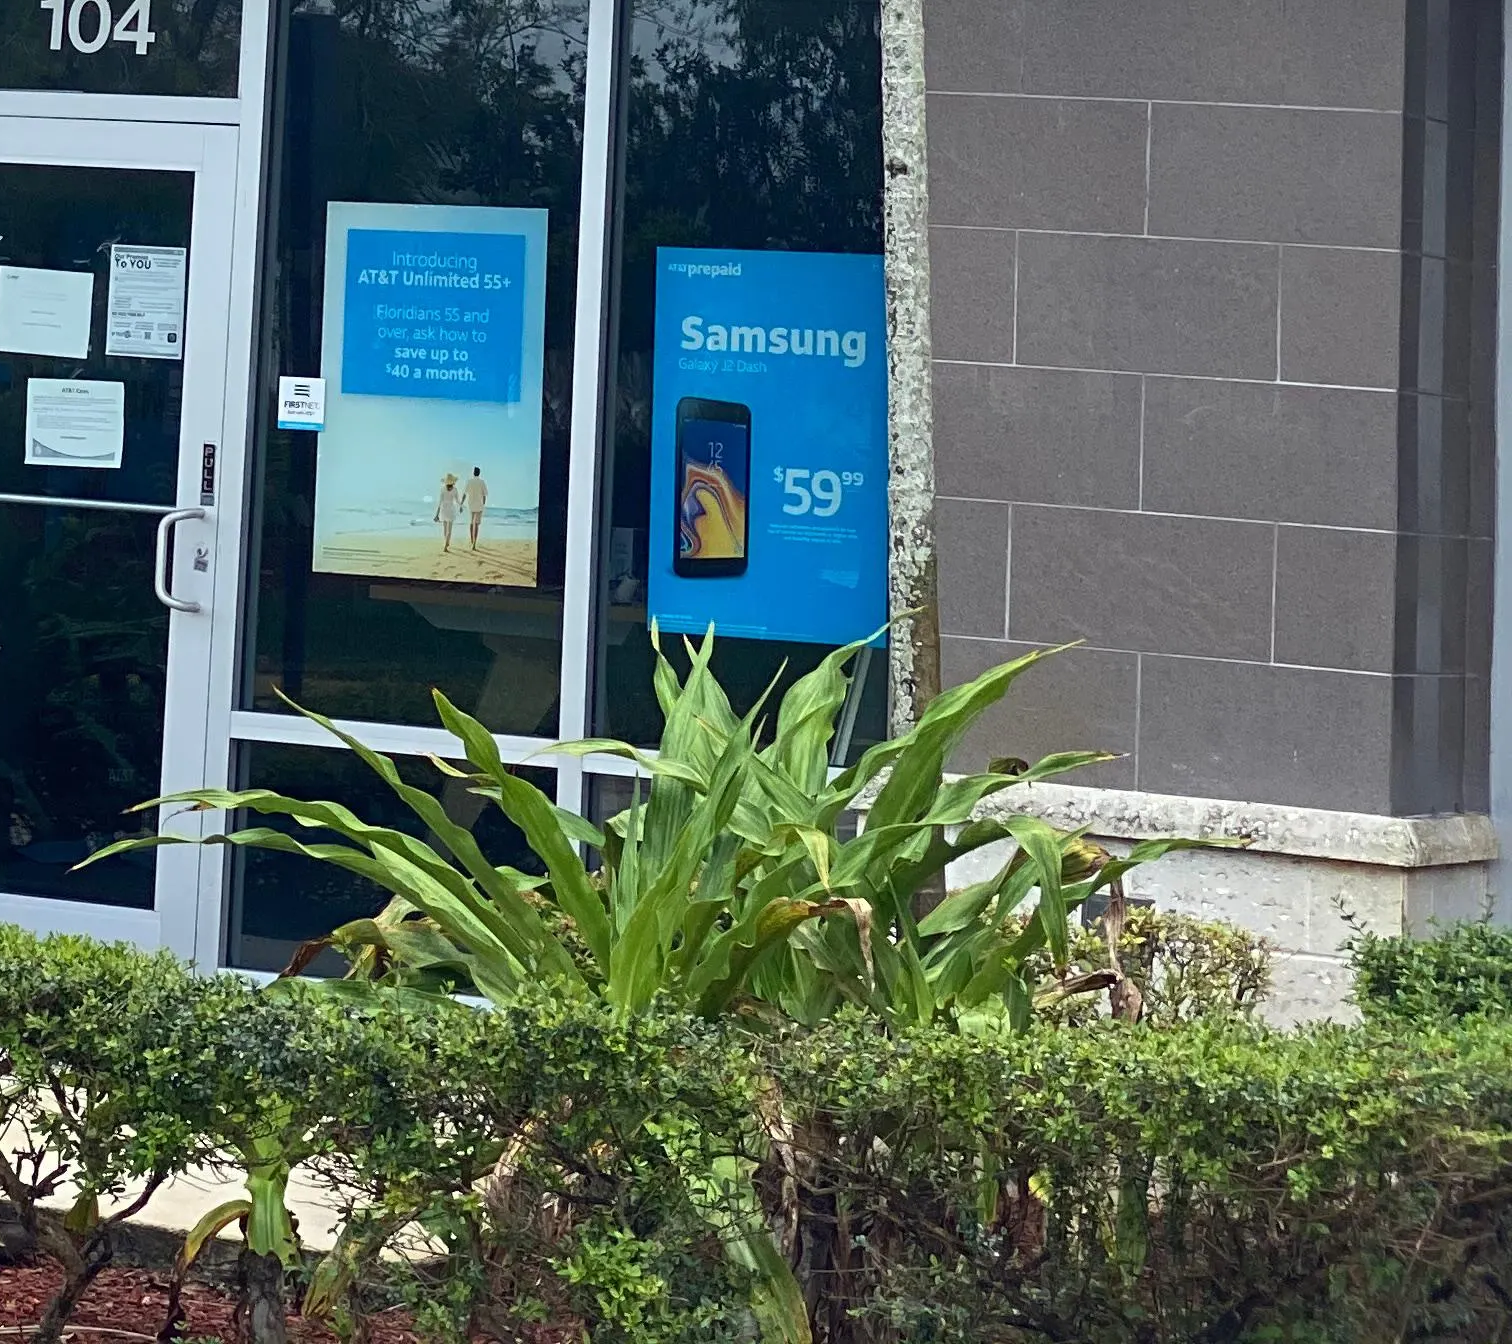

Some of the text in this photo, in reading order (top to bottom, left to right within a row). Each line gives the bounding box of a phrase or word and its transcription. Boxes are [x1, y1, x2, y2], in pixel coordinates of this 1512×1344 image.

[130, 259, 152, 269] YOU
[392, 251, 478, 274] Introducing
[687, 262, 742, 278] prepaid
[358, 269, 512, 289] AT&T Unlimited 55+
[376, 304, 490, 324] Floridians 55 and
[378, 326, 487, 343] over, ask how to
[680, 315, 867, 368] Samsung
[394, 347, 469, 364] save up to
[386, 363, 477, 382] $40 a month.
[678, 357, 719, 375] Galaxy
[737, 360, 768, 374] Dash
[203, 446, 214, 491] PULL
